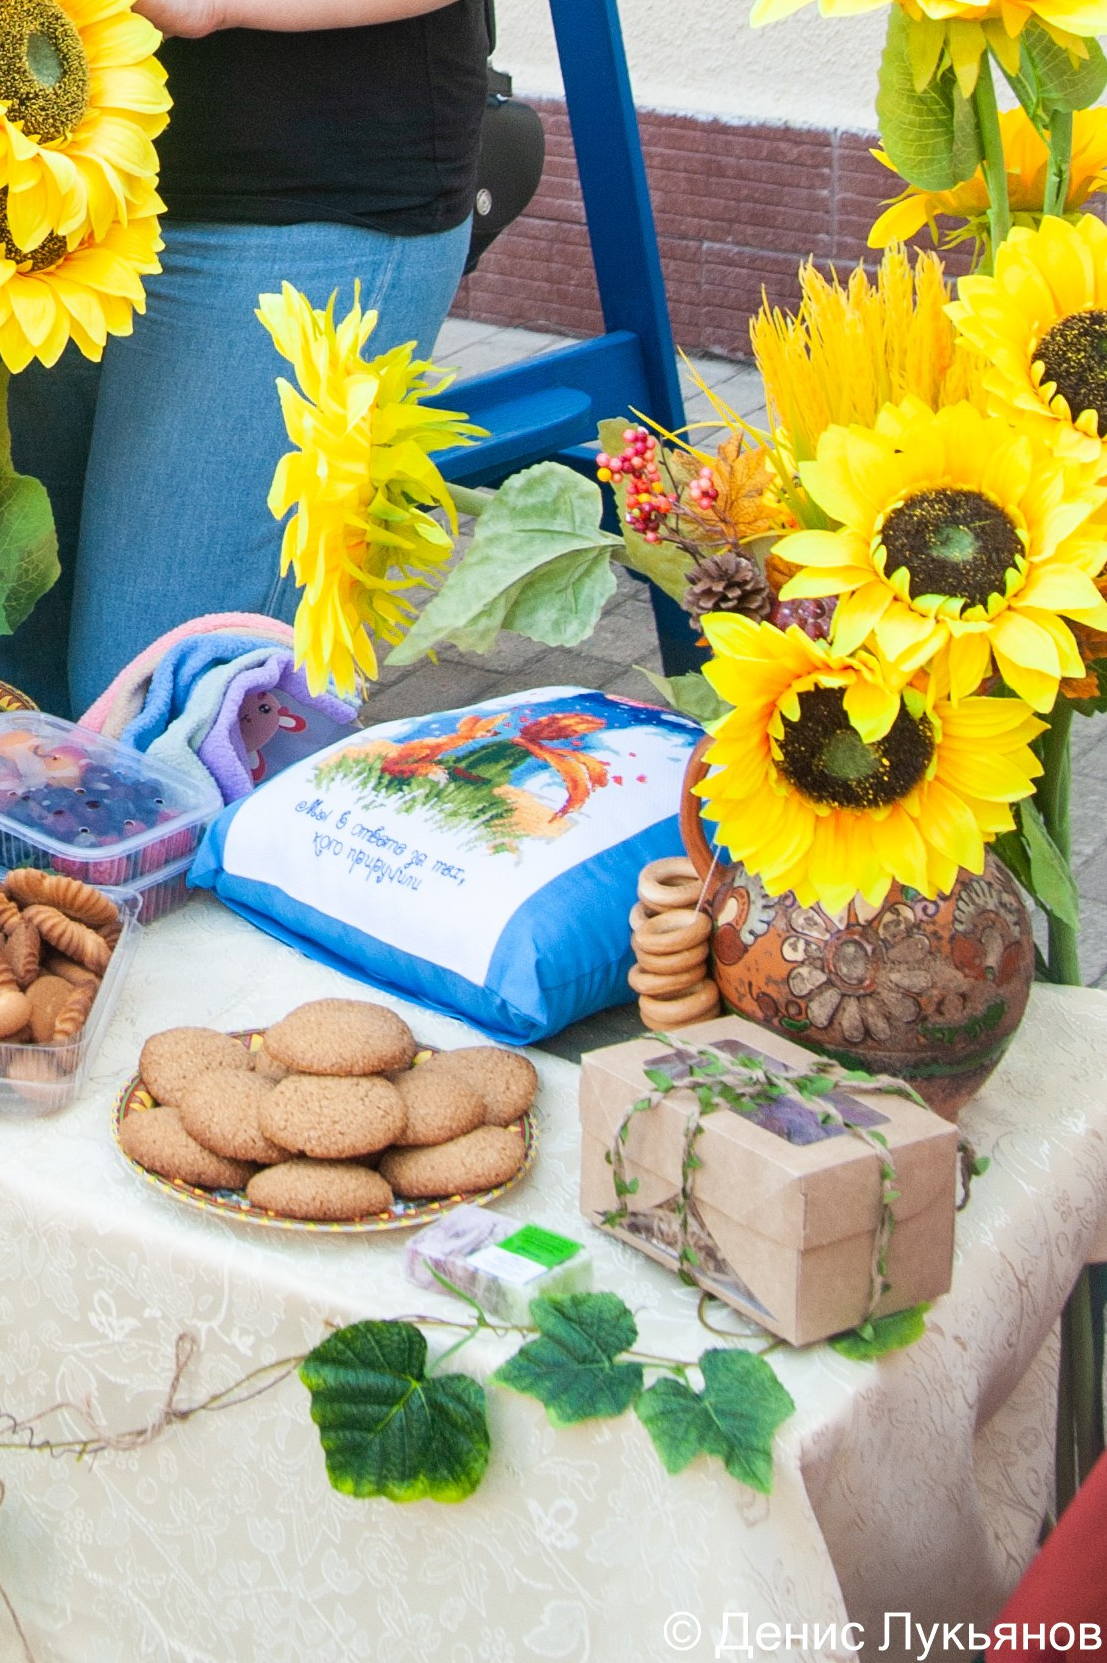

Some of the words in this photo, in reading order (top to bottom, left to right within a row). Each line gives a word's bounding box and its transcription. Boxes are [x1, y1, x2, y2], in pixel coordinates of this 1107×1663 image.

[294, 799, 333, 822] Мы
[351, 824, 407, 856] ответе
[404, 850, 427, 870] за
[431, 860, 466, 886] тех,
[312, 831, 343, 857] кого
[346, 847, 423, 891] приручили
